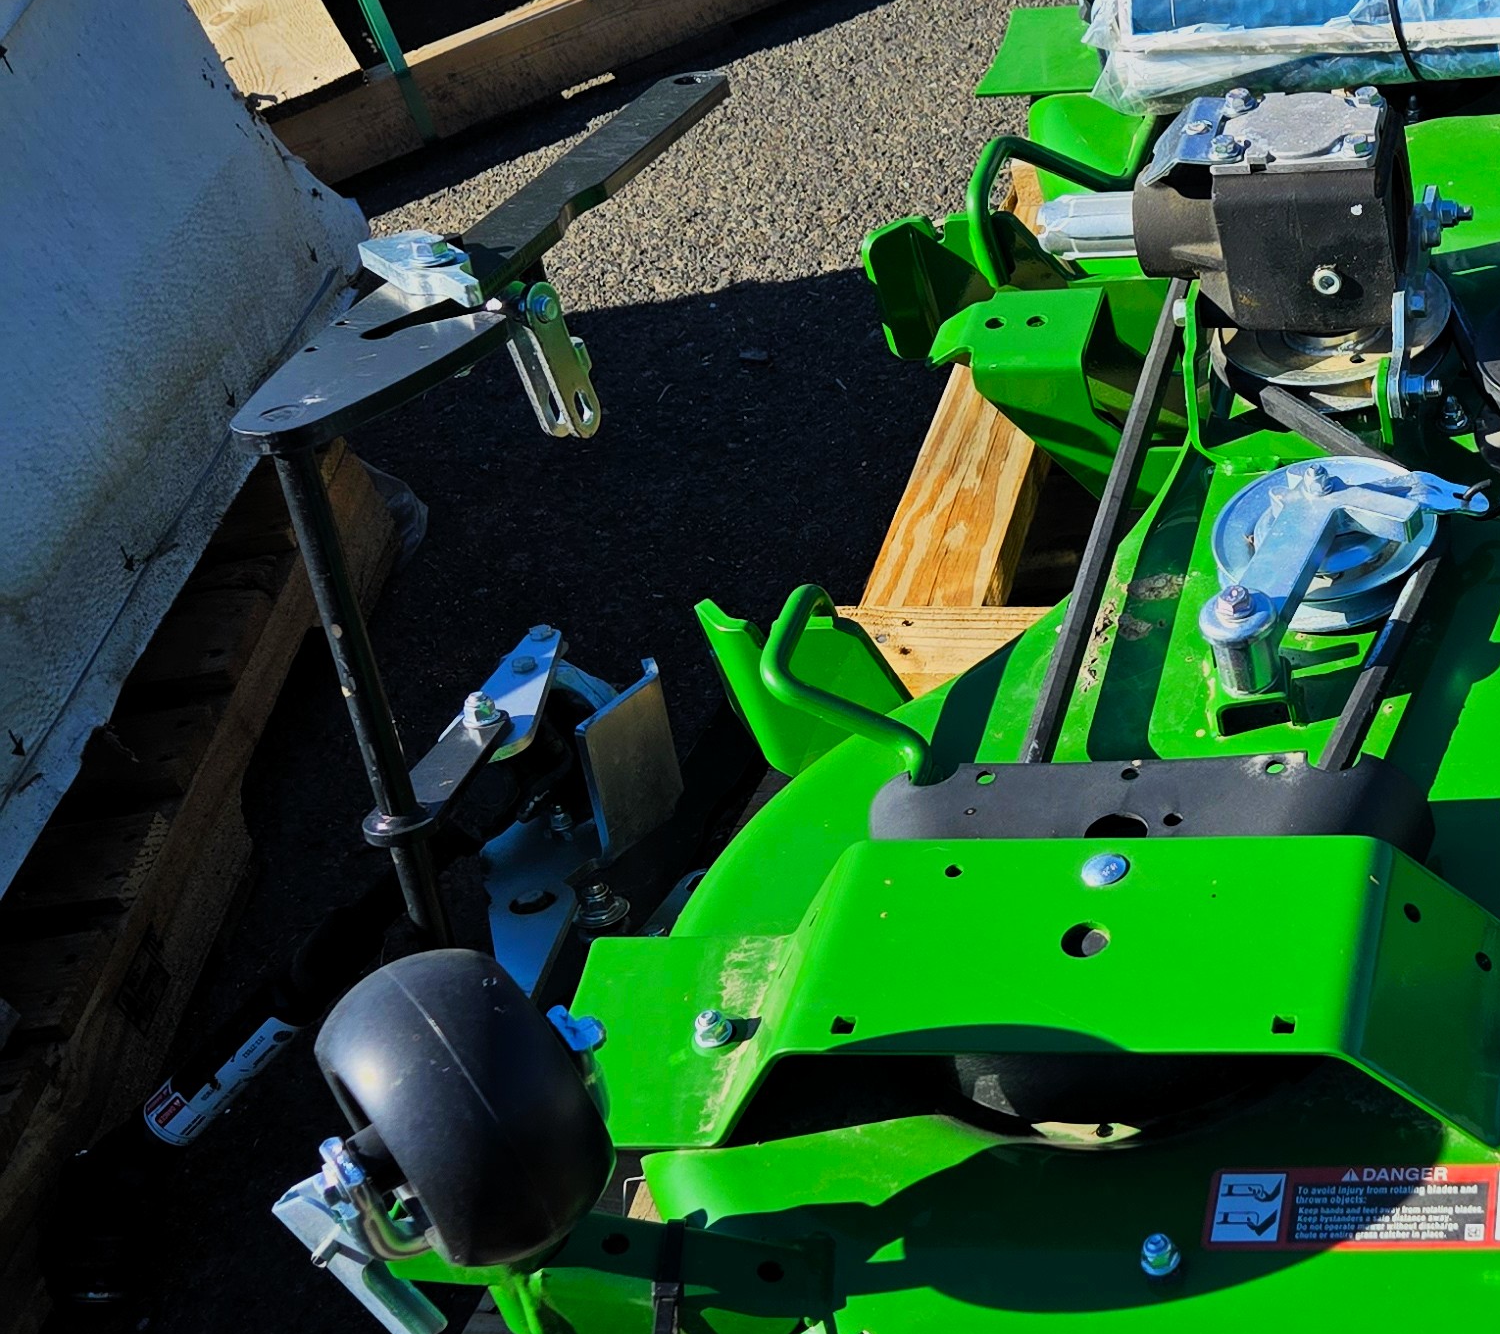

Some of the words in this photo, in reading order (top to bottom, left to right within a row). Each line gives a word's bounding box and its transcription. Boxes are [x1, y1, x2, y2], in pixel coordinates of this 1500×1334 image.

[1362, 1166, 1448, 1181] DANGER
[1298, 1186, 1309, 1195] To
[1311, 1186, 1336, 1195] avoid
[1337, 1186, 1364, 1196] injury
[1366, 1185, 1388, 1194] from
[1390, 1185, 1426, 1196] rotating
[1426, 1184, 1459, 1194] blades
[1460, 1184, 1478, 1194] and
[1295, 1195, 1328, 1204] thrown
[1330, 1195, 1367, 1205] objects:
[1298, 1207, 1319, 1215] Keep
[1346, 1206, 1361, 1214] and
[1297, 1215, 1318, 1223] Keep
